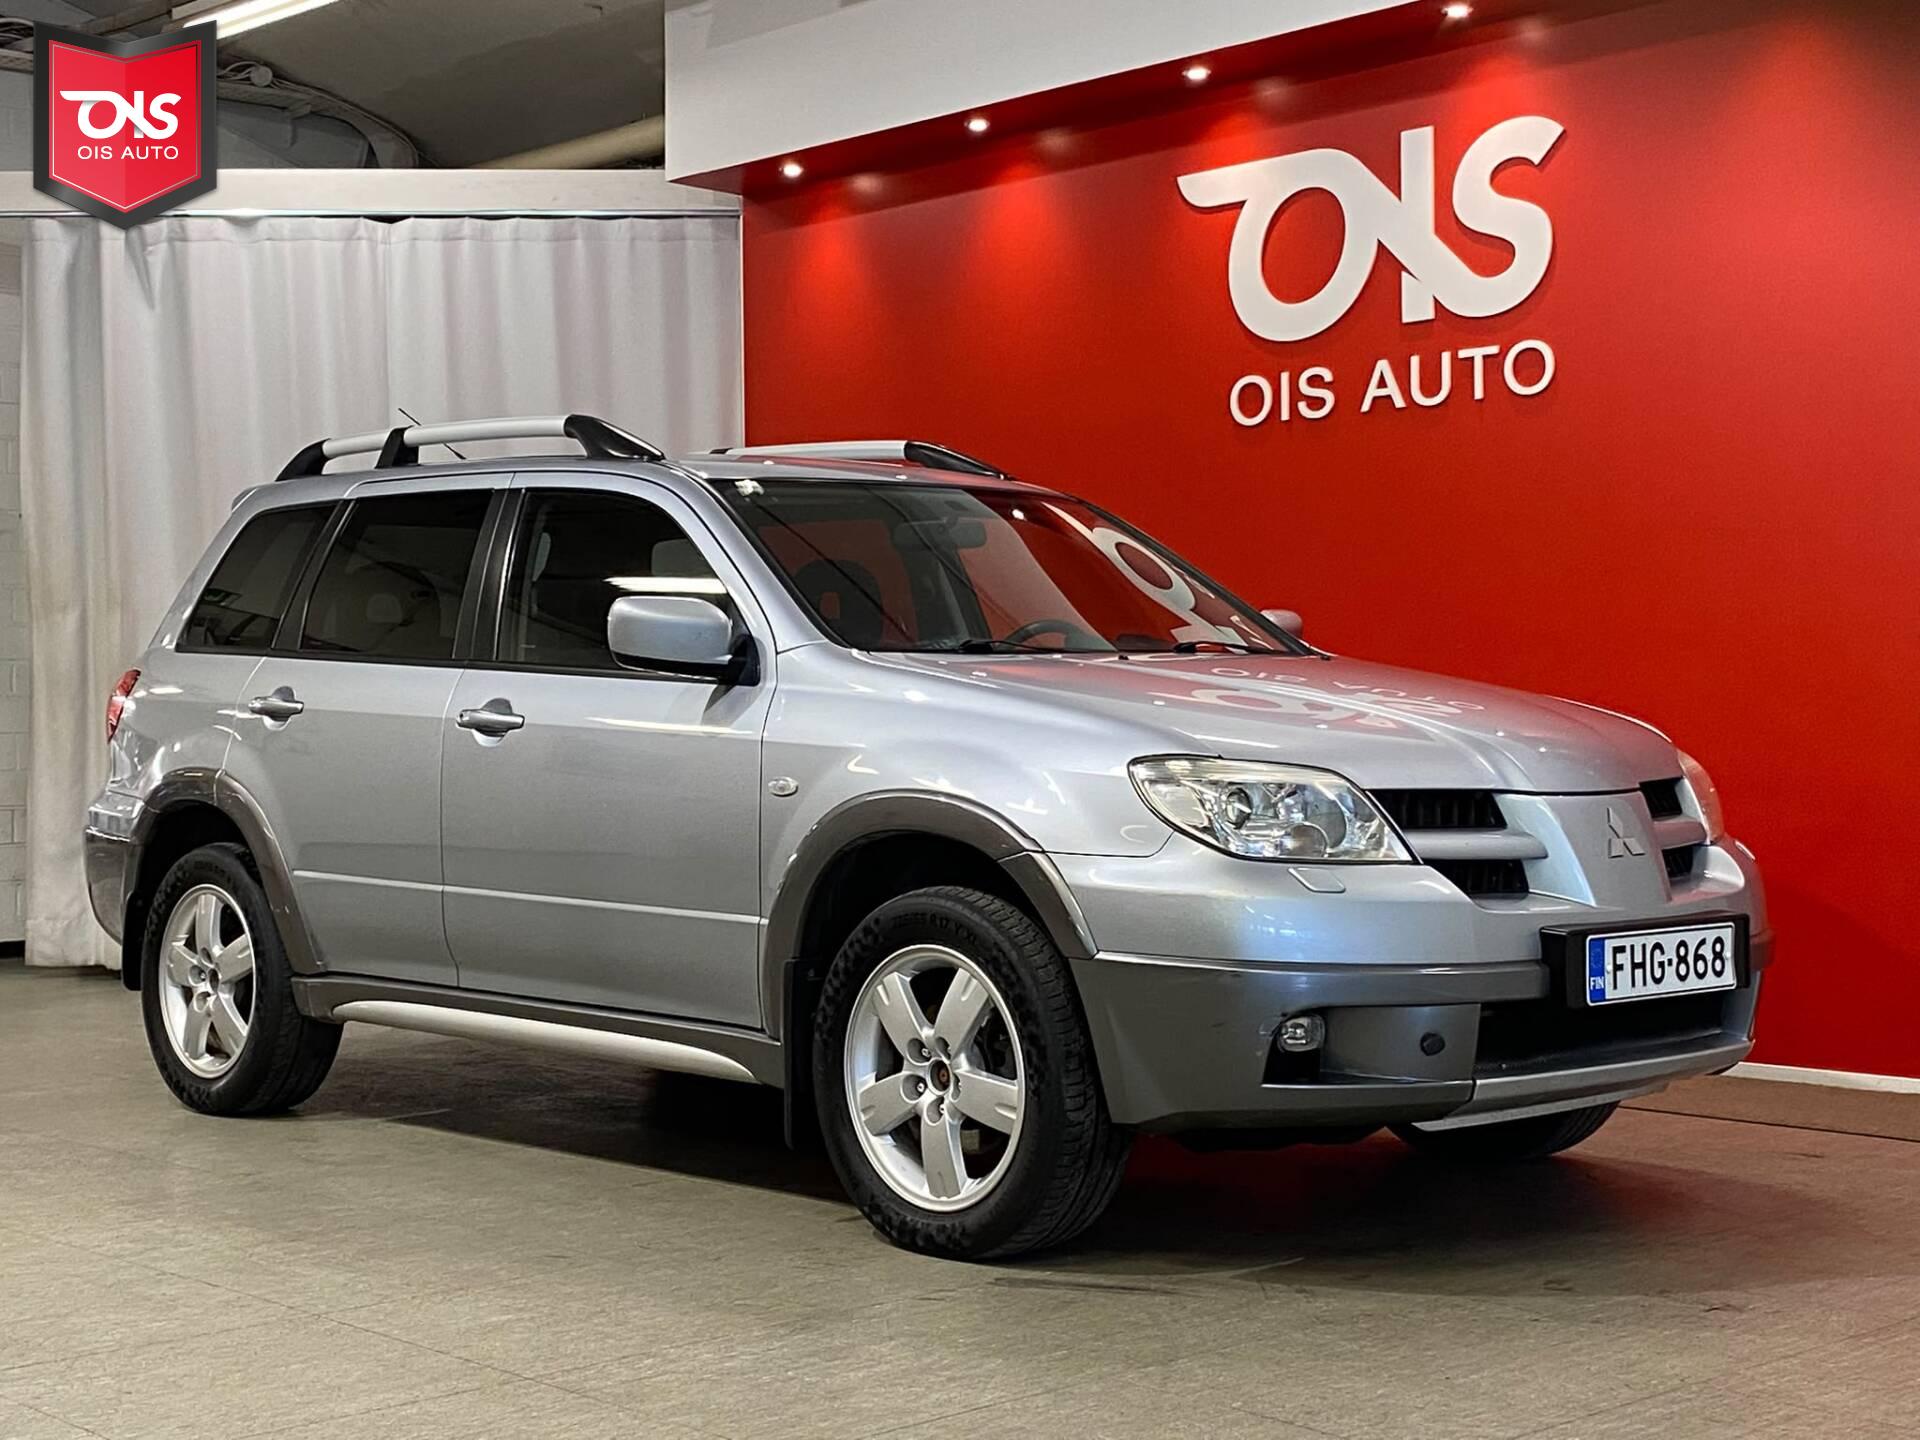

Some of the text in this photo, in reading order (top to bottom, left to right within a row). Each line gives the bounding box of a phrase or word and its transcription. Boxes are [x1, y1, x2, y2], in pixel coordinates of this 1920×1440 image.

[1229, 339, 1556, 427] OIS AUTO
[1590, 976, 1605, 991] FIN
[1611, 935, 1726, 991] FHG-868
